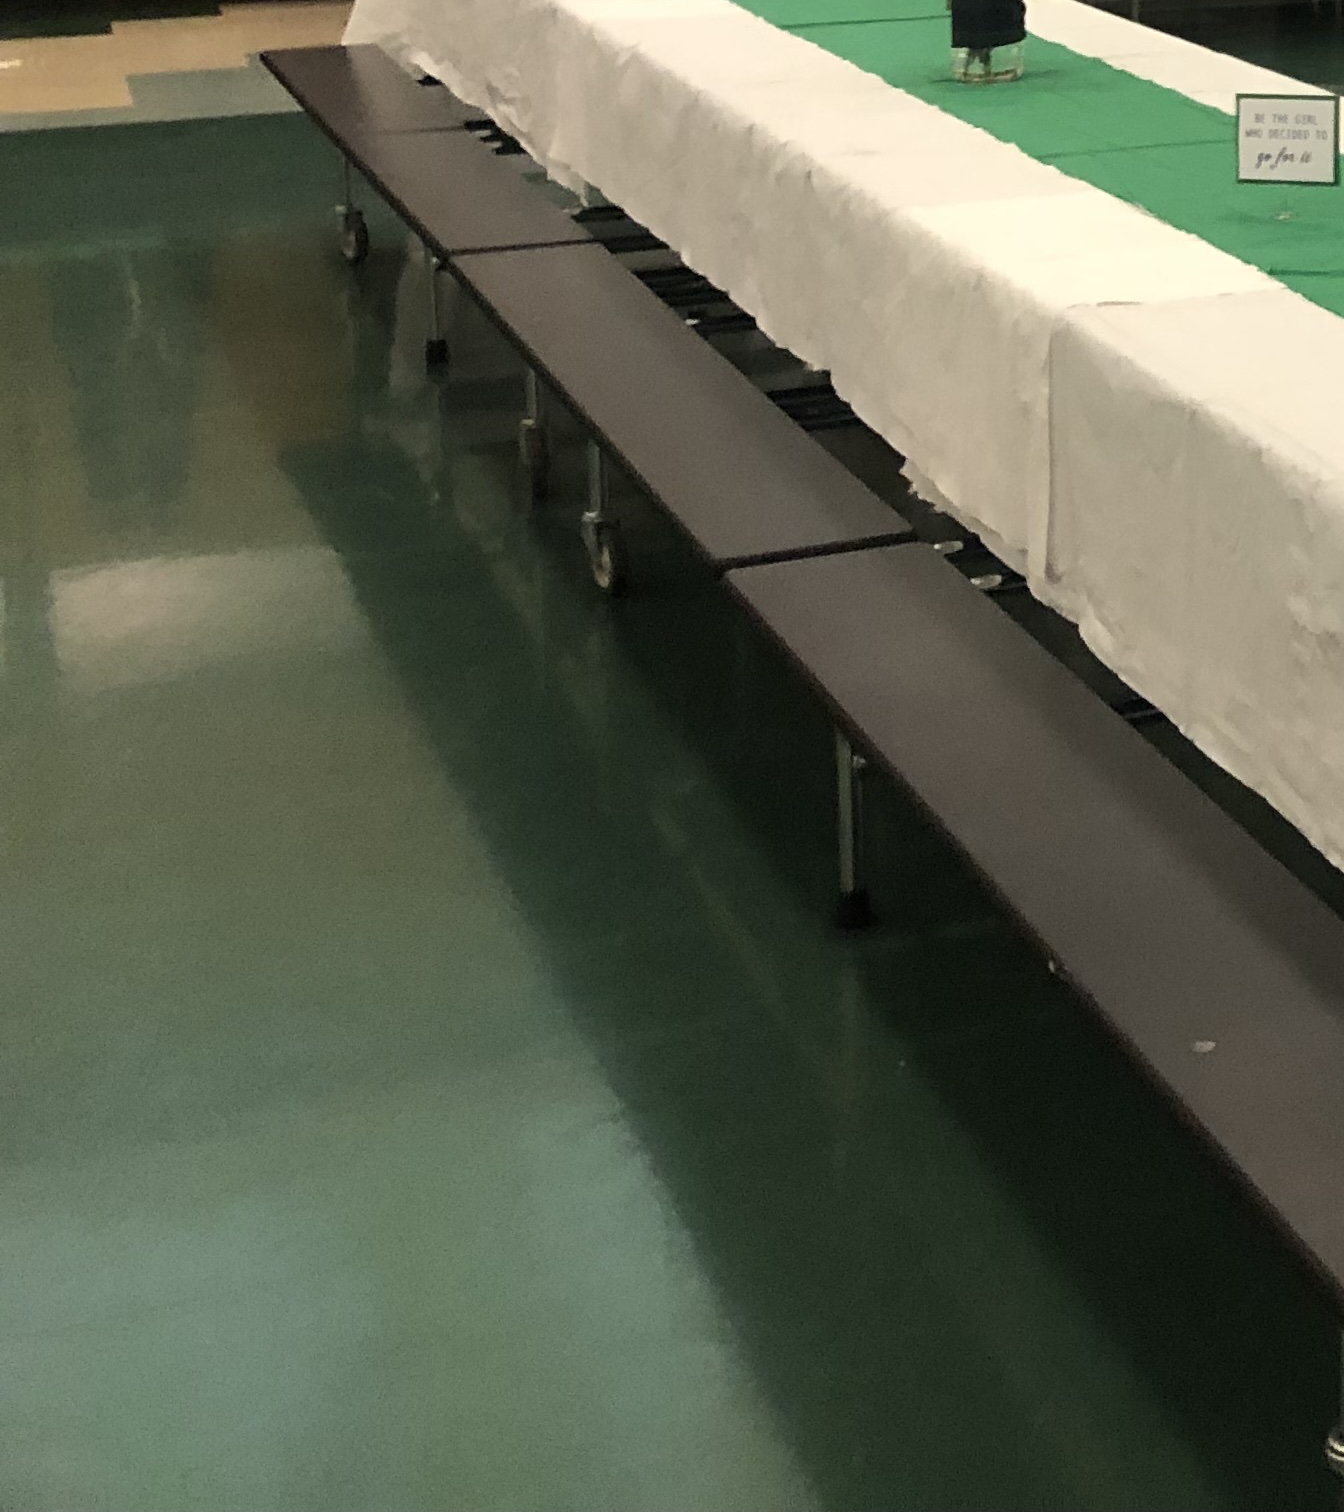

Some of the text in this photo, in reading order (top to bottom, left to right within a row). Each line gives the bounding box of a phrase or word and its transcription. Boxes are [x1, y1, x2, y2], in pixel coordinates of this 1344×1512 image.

[1254, 113, 1317, 125] BE THE GIRL
[1245, 129, 1327, 140] WHO DECIDED TO
[1255, 146, 1312, 170] go for it
